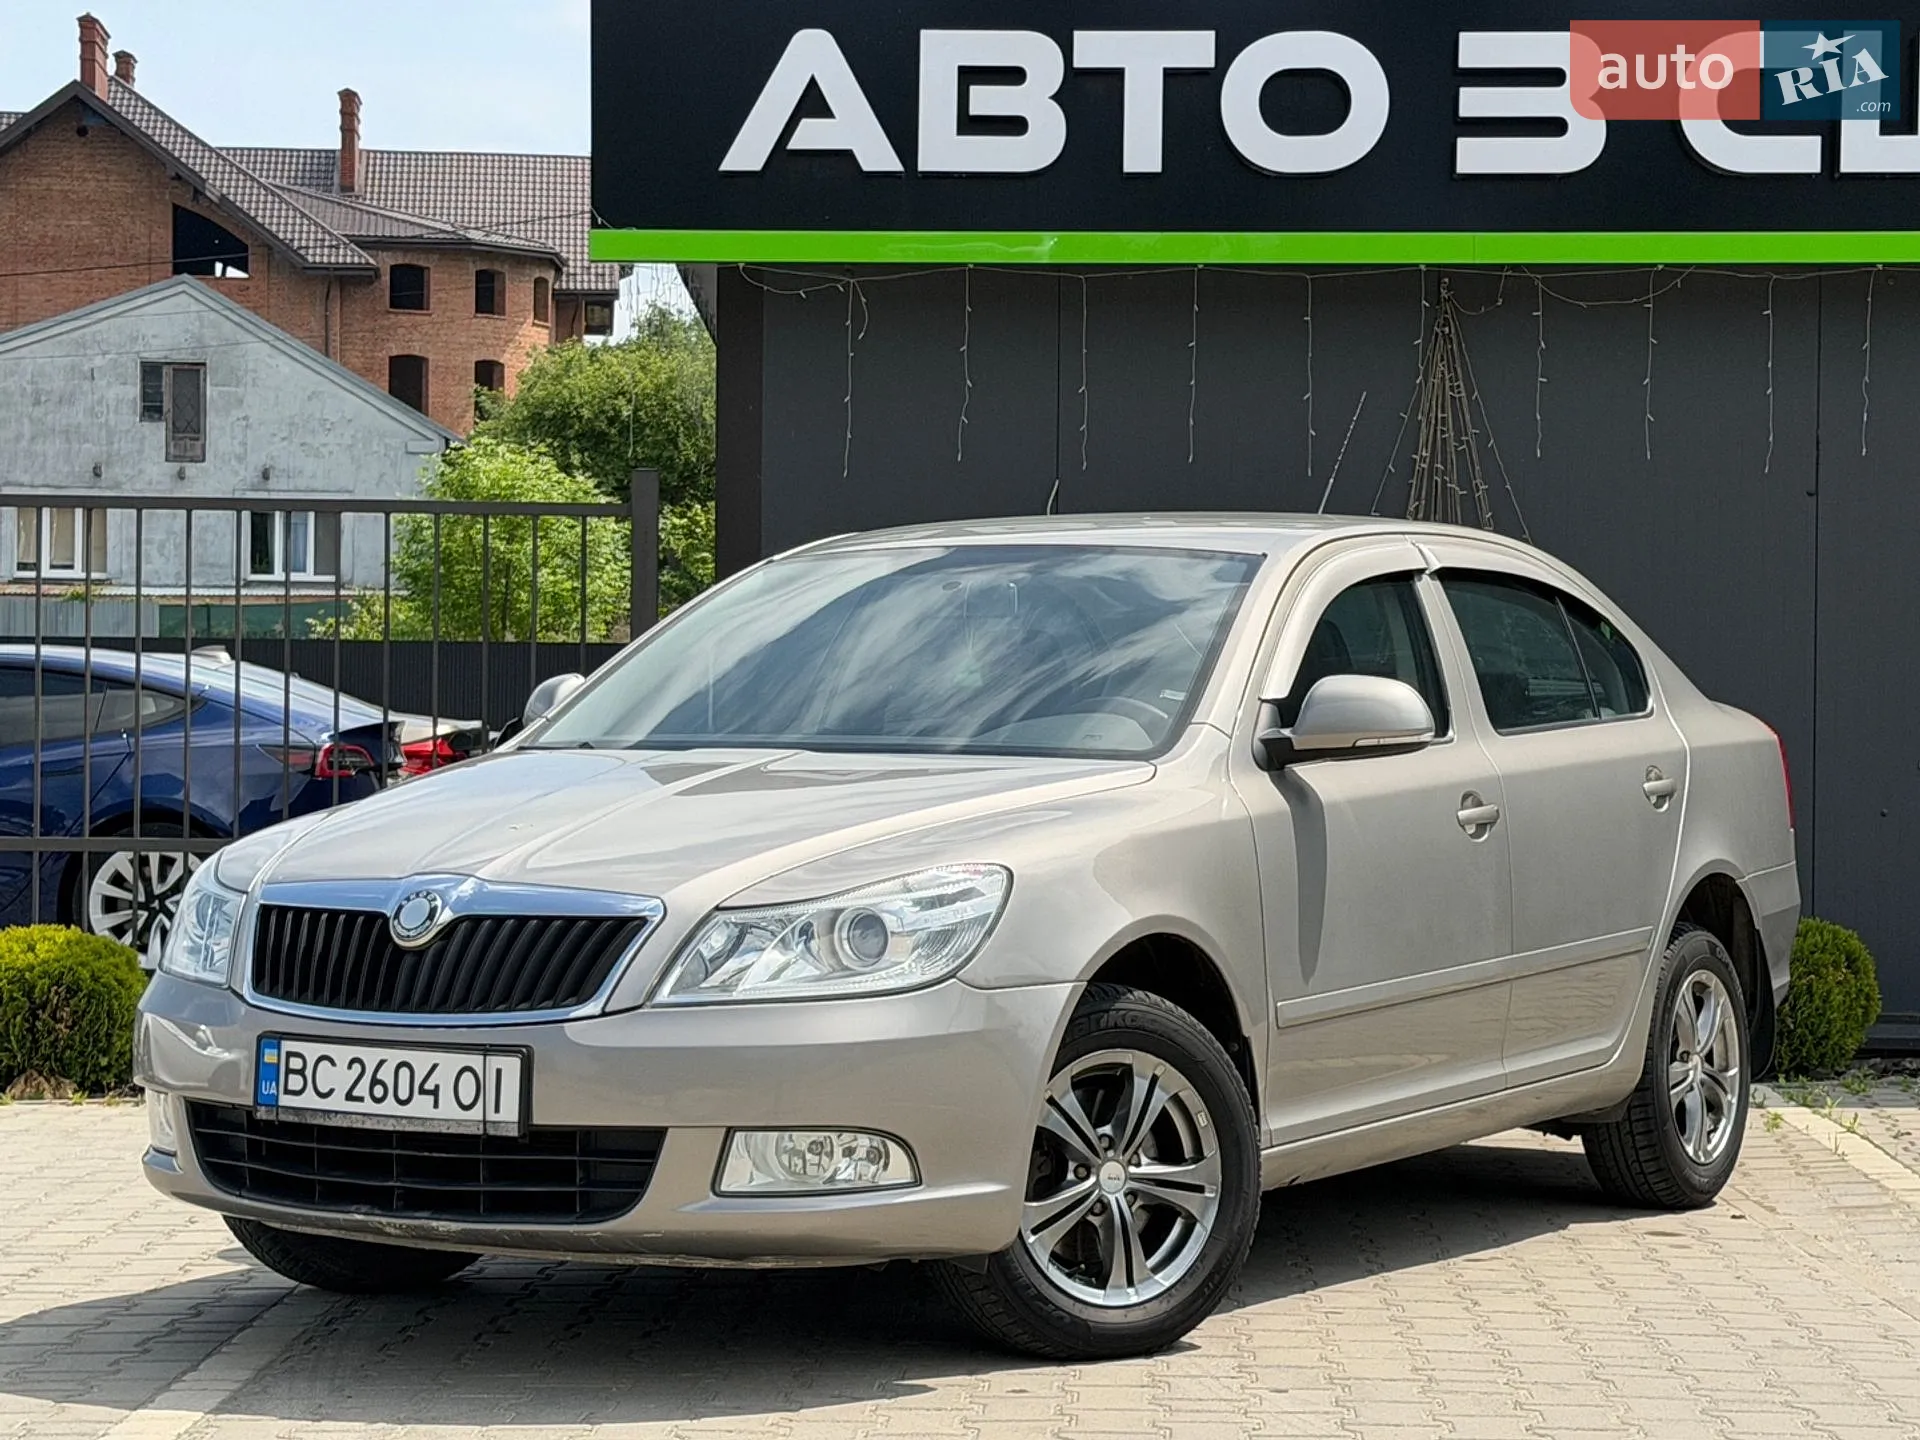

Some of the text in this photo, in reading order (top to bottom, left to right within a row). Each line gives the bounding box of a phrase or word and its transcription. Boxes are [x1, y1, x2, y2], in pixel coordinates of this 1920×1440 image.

[718, 28, 1390, 173] АВТО
[261, 1079, 278, 1096] UA
[282, 1050, 337, 1100] BC
[344, 1056, 440, 1110] 2604
